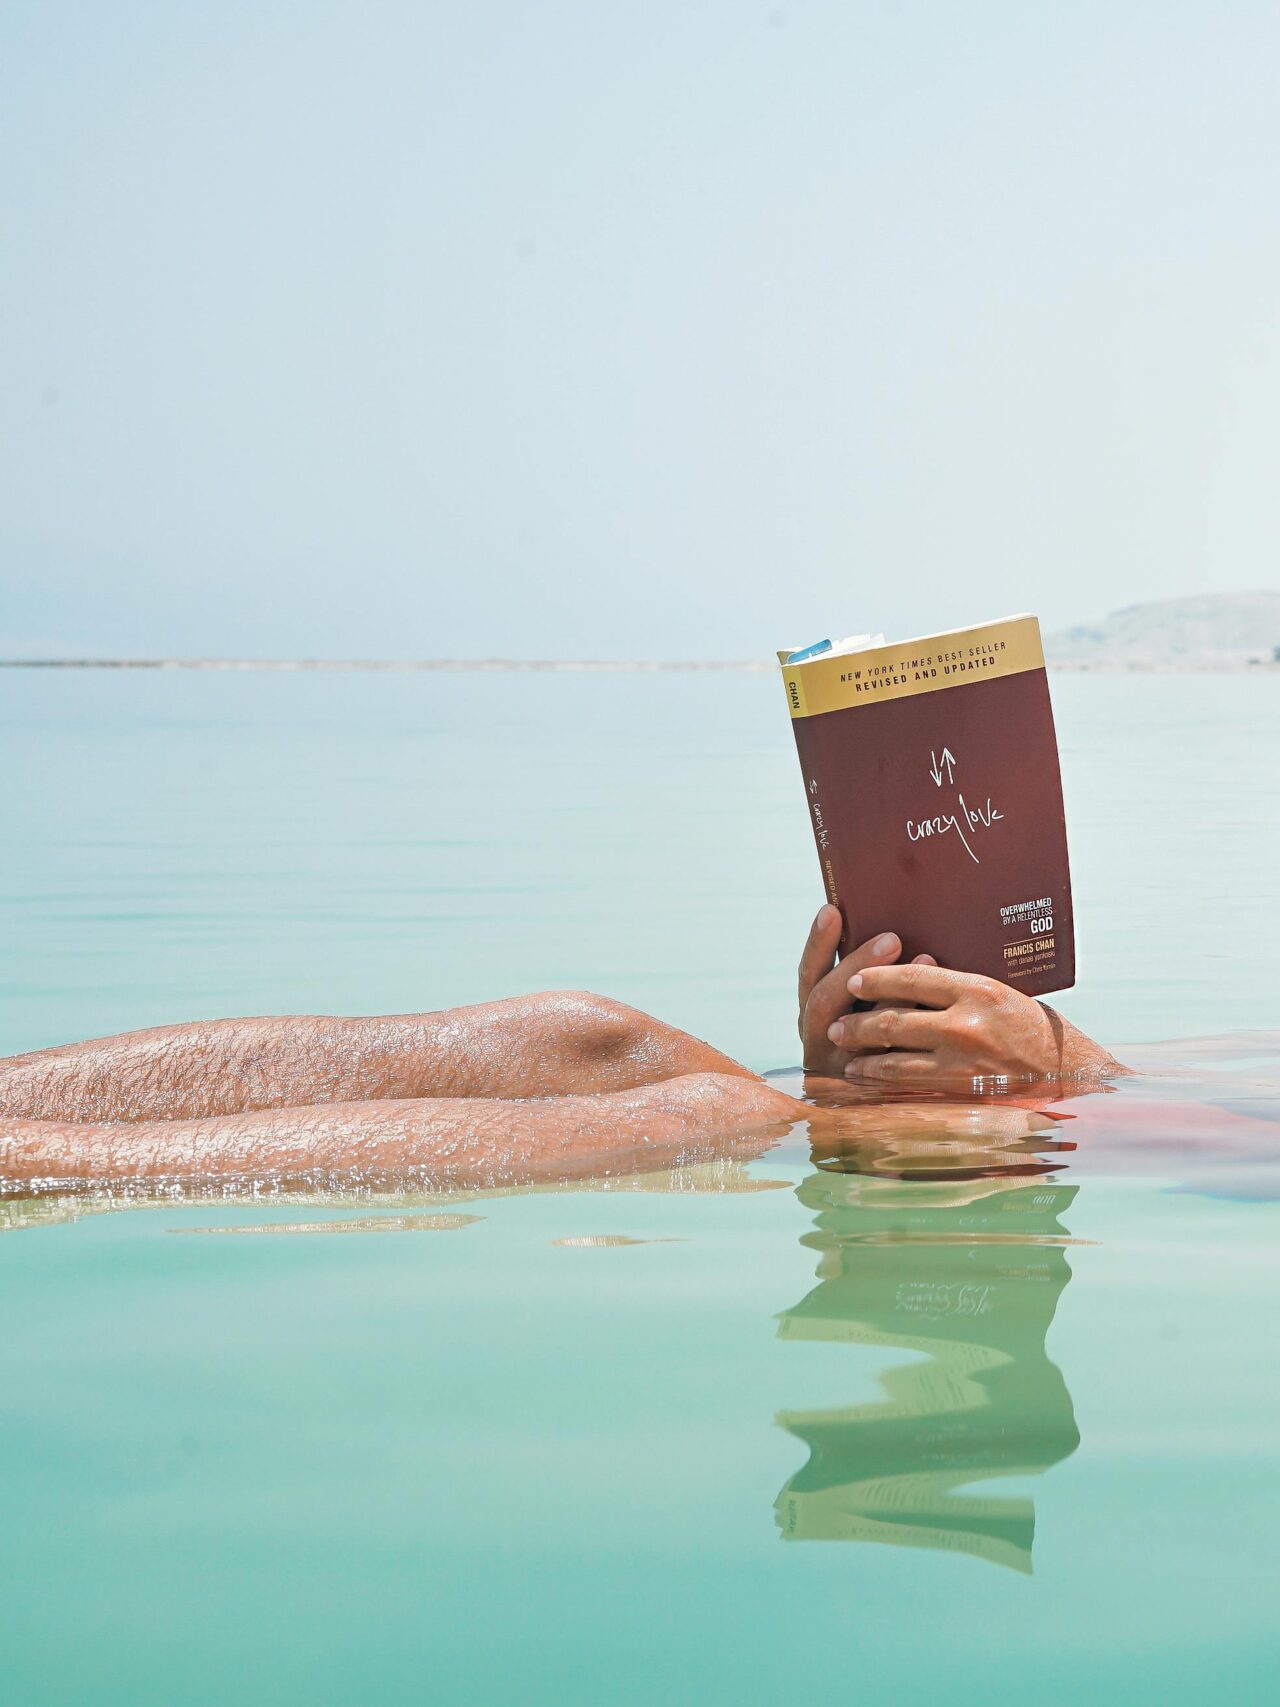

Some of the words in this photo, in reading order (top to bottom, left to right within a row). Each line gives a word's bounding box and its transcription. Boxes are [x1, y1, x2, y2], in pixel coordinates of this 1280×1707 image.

[840, 671, 862, 683] NEW
[867, 665, 895, 677] YORK
[900, 657, 933, 671] TIMES
[938, 651, 964, 663] BEST
[969, 641, 1007, 657] SELLER
[855, 674, 908, 692] REVISED
[914, 668, 938, 681] AND
[944, 656, 996, 675] UPDATED
[788, 681, 801, 709] CHAN
[813, 803, 824, 830] crazy
[906, 814, 980, 864] crazy
[958, 793, 1005, 833] love
[824, 860, 836, 891] REVISED
[1000, 897, 1052, 917] OVERWHELMED
[1002, 916, 1011, 926] BY
[1017, 907, 1053, 922] RELENTLESS
[1030, 916, 1053, 934] GOD
[1003, 943, 1034, 959] FRANCIS
[1035, 938, 1055, 952] CHAN
